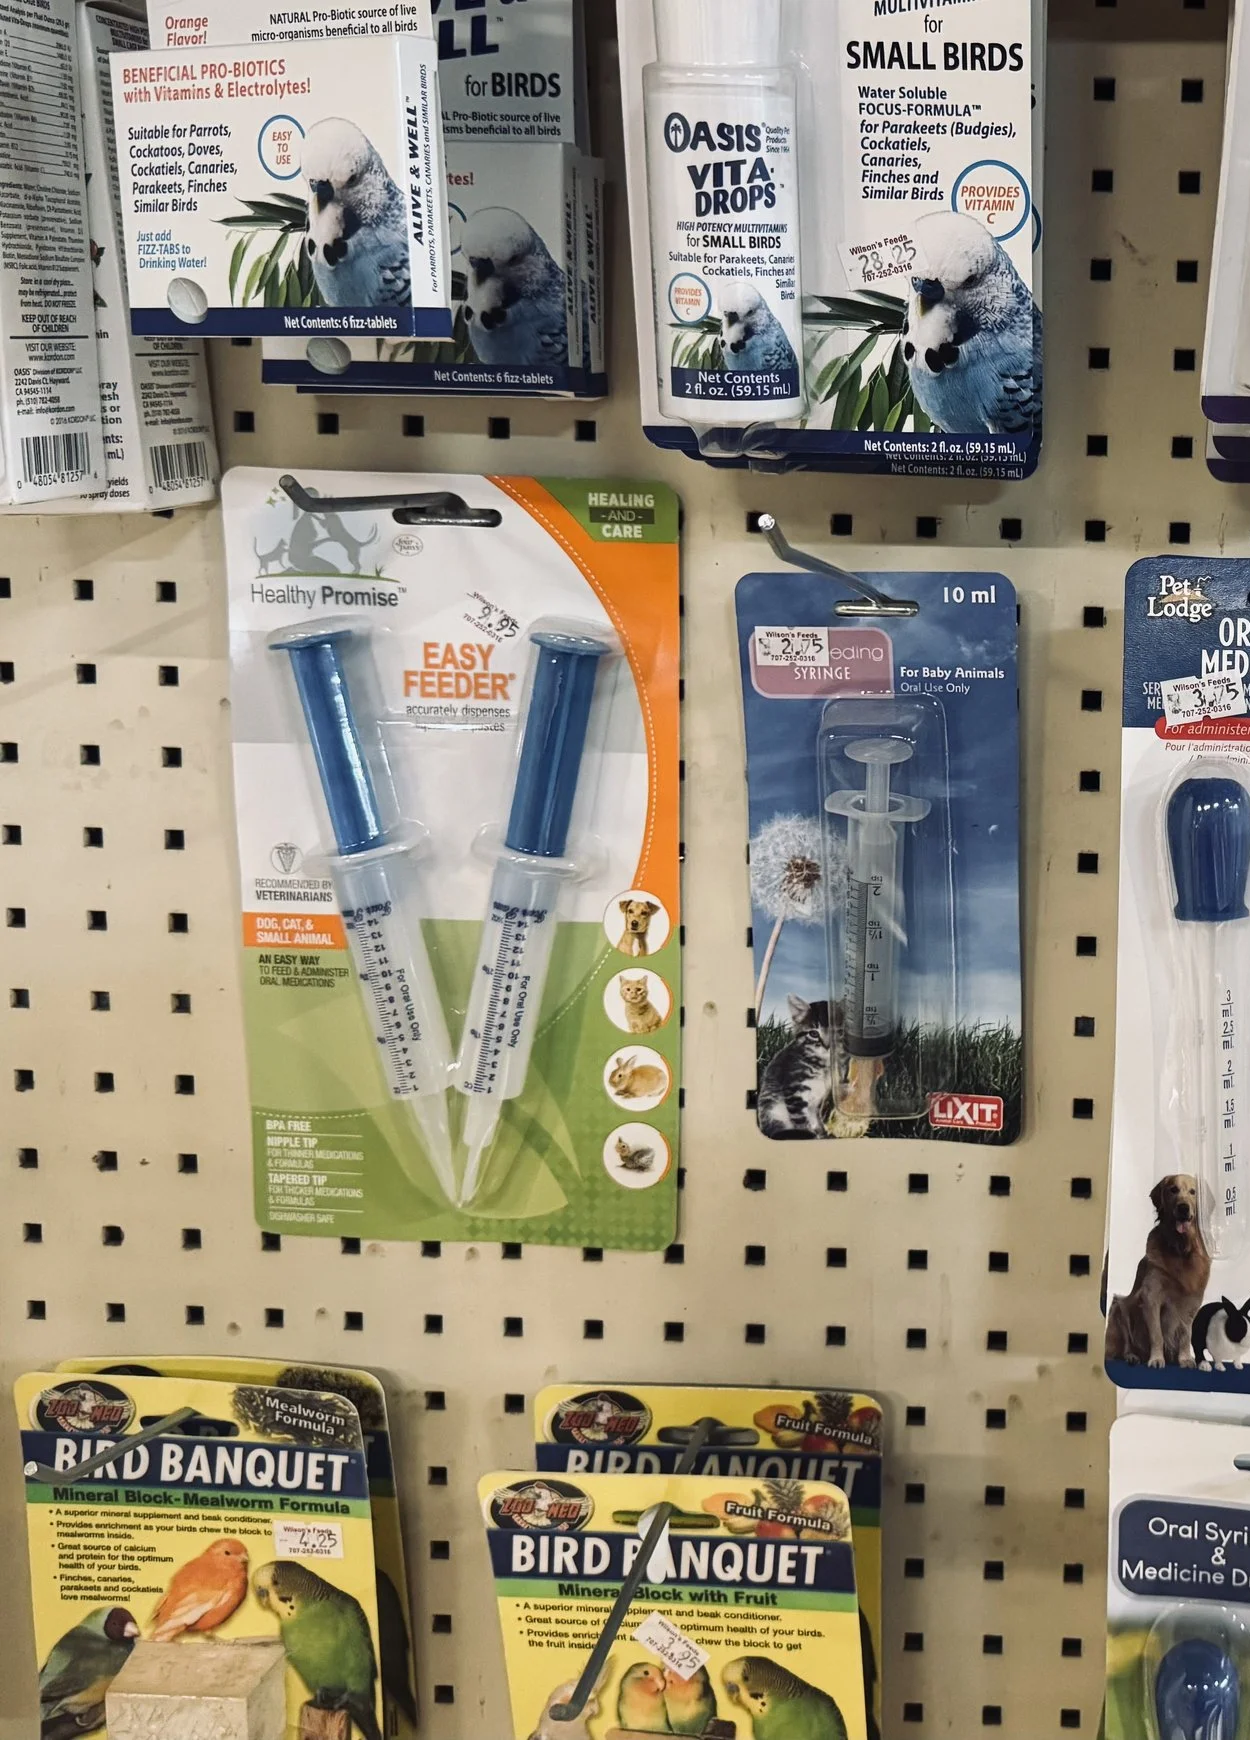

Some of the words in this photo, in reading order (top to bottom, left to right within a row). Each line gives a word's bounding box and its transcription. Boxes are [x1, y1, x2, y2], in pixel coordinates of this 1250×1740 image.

[165, 16, 208, 31] Orange
[167, 31, 206, 46] Flavor!
[847, 41, 936, 70] SMALL
[944, 42, 1023, 71] BIRDS
[123, 65, 197, 87] BENEFICIAL
[201, 59, 285, 79] PRO-BIOTICS
[124, 86, 151, 103] with
[154, 84, 210, 101] Vitamins
[215, 83, 223, 98] &
[228, 78, 310, 99] Electrolytes!
[858, 86, 895, 98] Water
[899, 86, 947, 99] Soluble
[128, 125, 170, 141] Suitable
[172, 124, 187, 138] for
[190, 124, 231, 137] Parrots,
[860, 119, 879, 133] for
[882, 121, 947, 134] Parakeets
[951, 122, 1016, 139] (Budgies),
[130, 144, 184, 158] Cockatoos,
[188, 143, 223, 156] Doves,
[861, 137, 930, 153] Cockatiels,
[131, 161, 185, 176] Cockatiels,
[188, 160, 237, 175] Canaries,
[861, 153, 921, 169] Canaries,
[133, 180, 185, 195] Parakeets,
[188, 179, 227, 192] Finches
[961, 184, 1020, 200] PROVIDES
[965, 199, 1014, 211] VITAMIN
[987, 213, 995, 224] C
[284, 316, 300, 328] Net
[301, 316, 341, 328] Contents:
[343, 317, 348, 328] 6
[349, 316, 397, 328] fizz-tablets
[865, 440, 881, 451] Net
[884, 440, 929, 452] Contents:
[932, 442, 937, 452] 2
[588, 493, 654, 507] HEALING
[602, 524, 642, 538] CARE
[1160, 575, 1191, 596] Pet
[252, 584, 316, 609] Healthy
[944, 587, 964, 603] 10
[972, 585, 995, 603] ml
[1147, 594, 1212, 622] Lodge
[424, 642, 494, 671] EASY
[794, 667, 850, 679] SYRINGE
[901, 667, 918, 677] For
[923, 667, 951, 680] Baby
[955, 668, 1004, 678] Animals
[901, 682, 921, 692] Oral
[925, 683, 943, 692] Use
[946, 683, 970, 694] Only
[462, 704, 510, 718] dispenses
[256, 890, 332, 902] VETERINARIANS
[266, 1396, 345, 1427] Mealworm
[276, 1408, 334, 1435] Formula
[53, 1487, 118, 1503] Mineral
[280, 1497, 350, 1514] Formula
[727, 1503, 762, 1517] Fruit
[768, 1509, 830, 1530] Formula
[1149, 1517, 1198, 1539] Oral
[1212, 1547, 1225, 1565] &
[1122, 1560, 1224, 1584] Medicine
